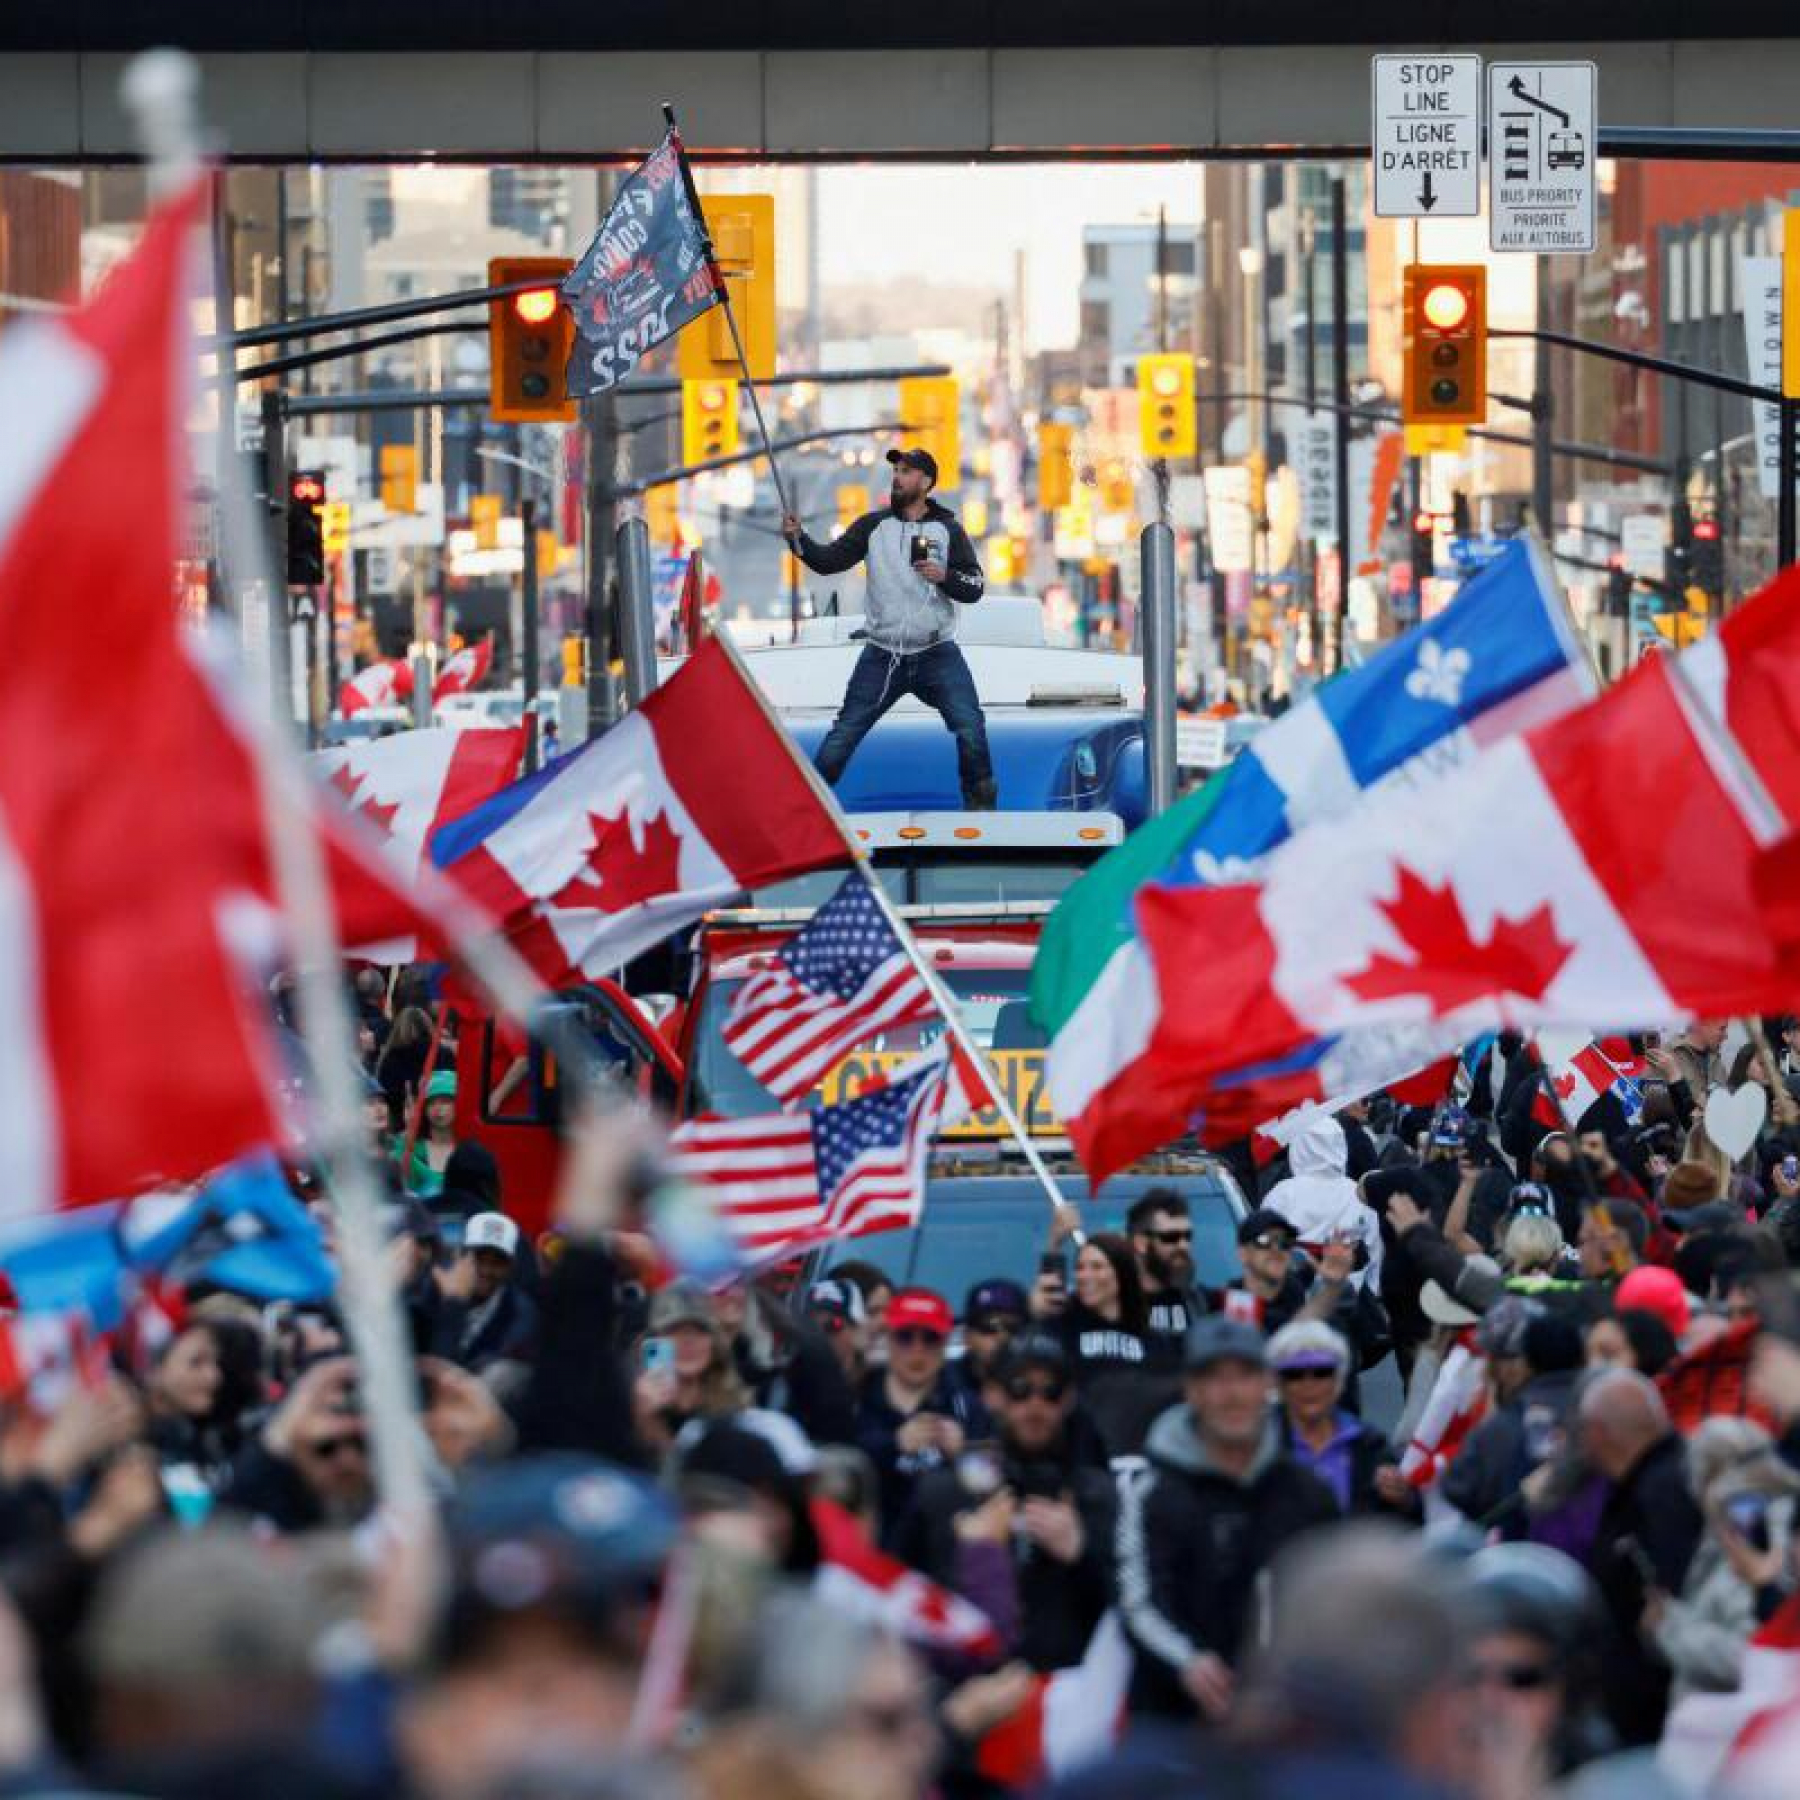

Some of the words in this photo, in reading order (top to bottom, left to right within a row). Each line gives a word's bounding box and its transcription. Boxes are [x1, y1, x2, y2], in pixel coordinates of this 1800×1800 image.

[1400, 64, 1454, 84] STOP
[1403, 92, 1450, 111] LINE
[1397, 123, 1457, 143] LIGNE
[1500, 188, 1525, 203] BUS
[1527, 188, 1583, 203] PRIORITY
[1500, 231, 1524, 244] AUX
[1529, 231, 1585, 244] AUTOBUS
